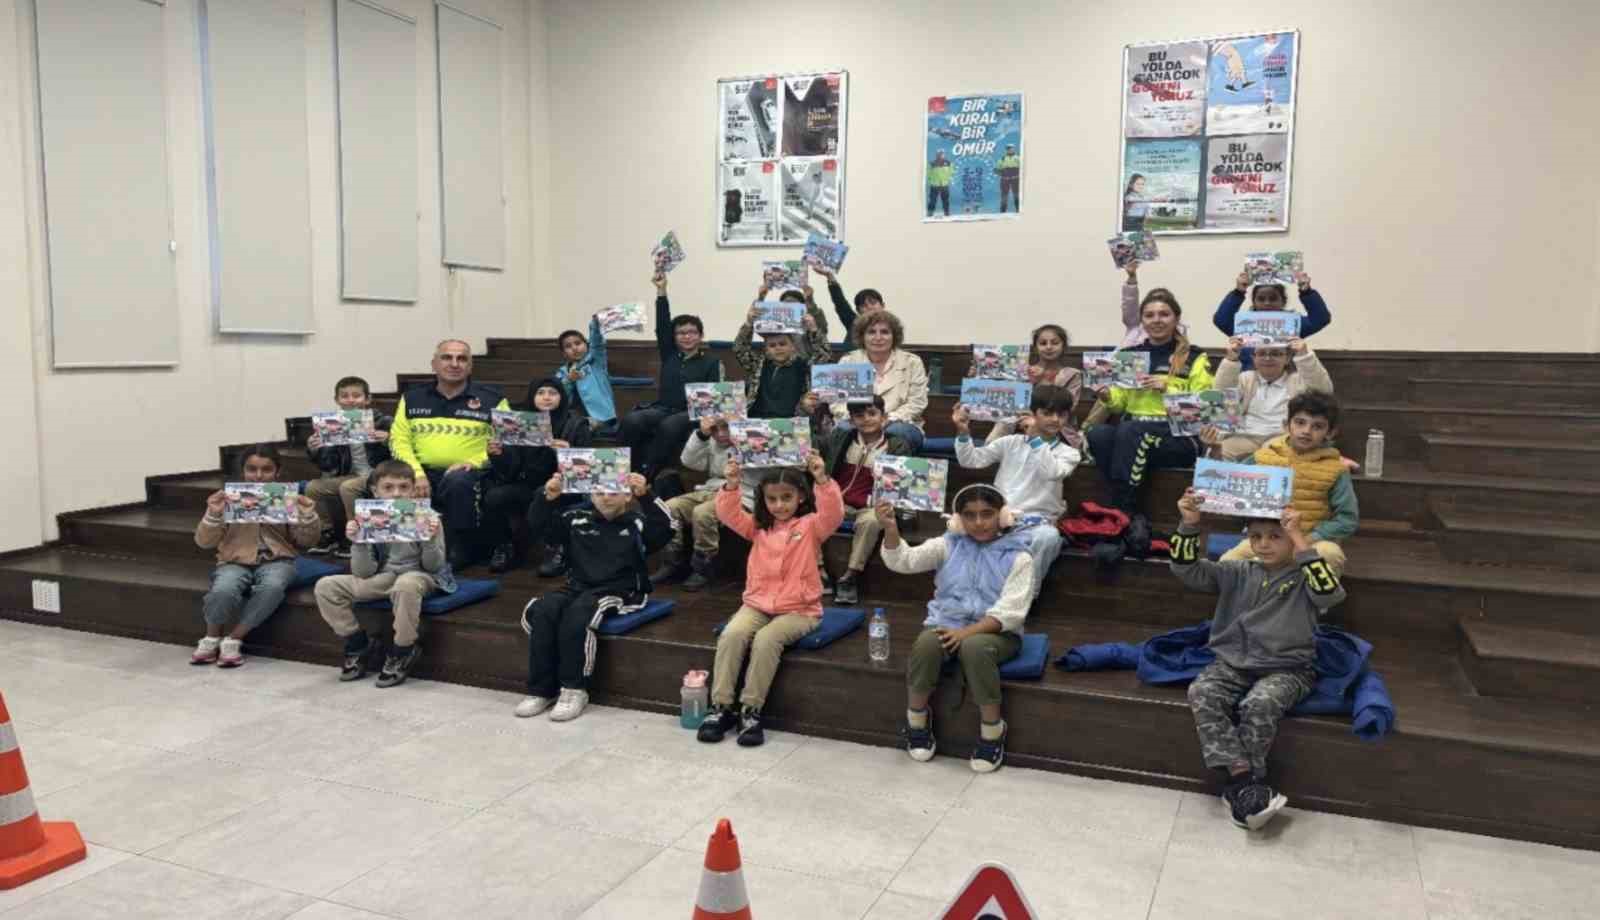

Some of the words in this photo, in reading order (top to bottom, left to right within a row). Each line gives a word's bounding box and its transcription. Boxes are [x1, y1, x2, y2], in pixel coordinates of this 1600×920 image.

[1148, 50, 1167, 61] BU
[1141, 60, 1183, 72] YOLDA
[949, 111, 998, 126] KURAL
[1228, 142, 1247, 153] BU
[1220, 152, 1264, 164] YOLDA
